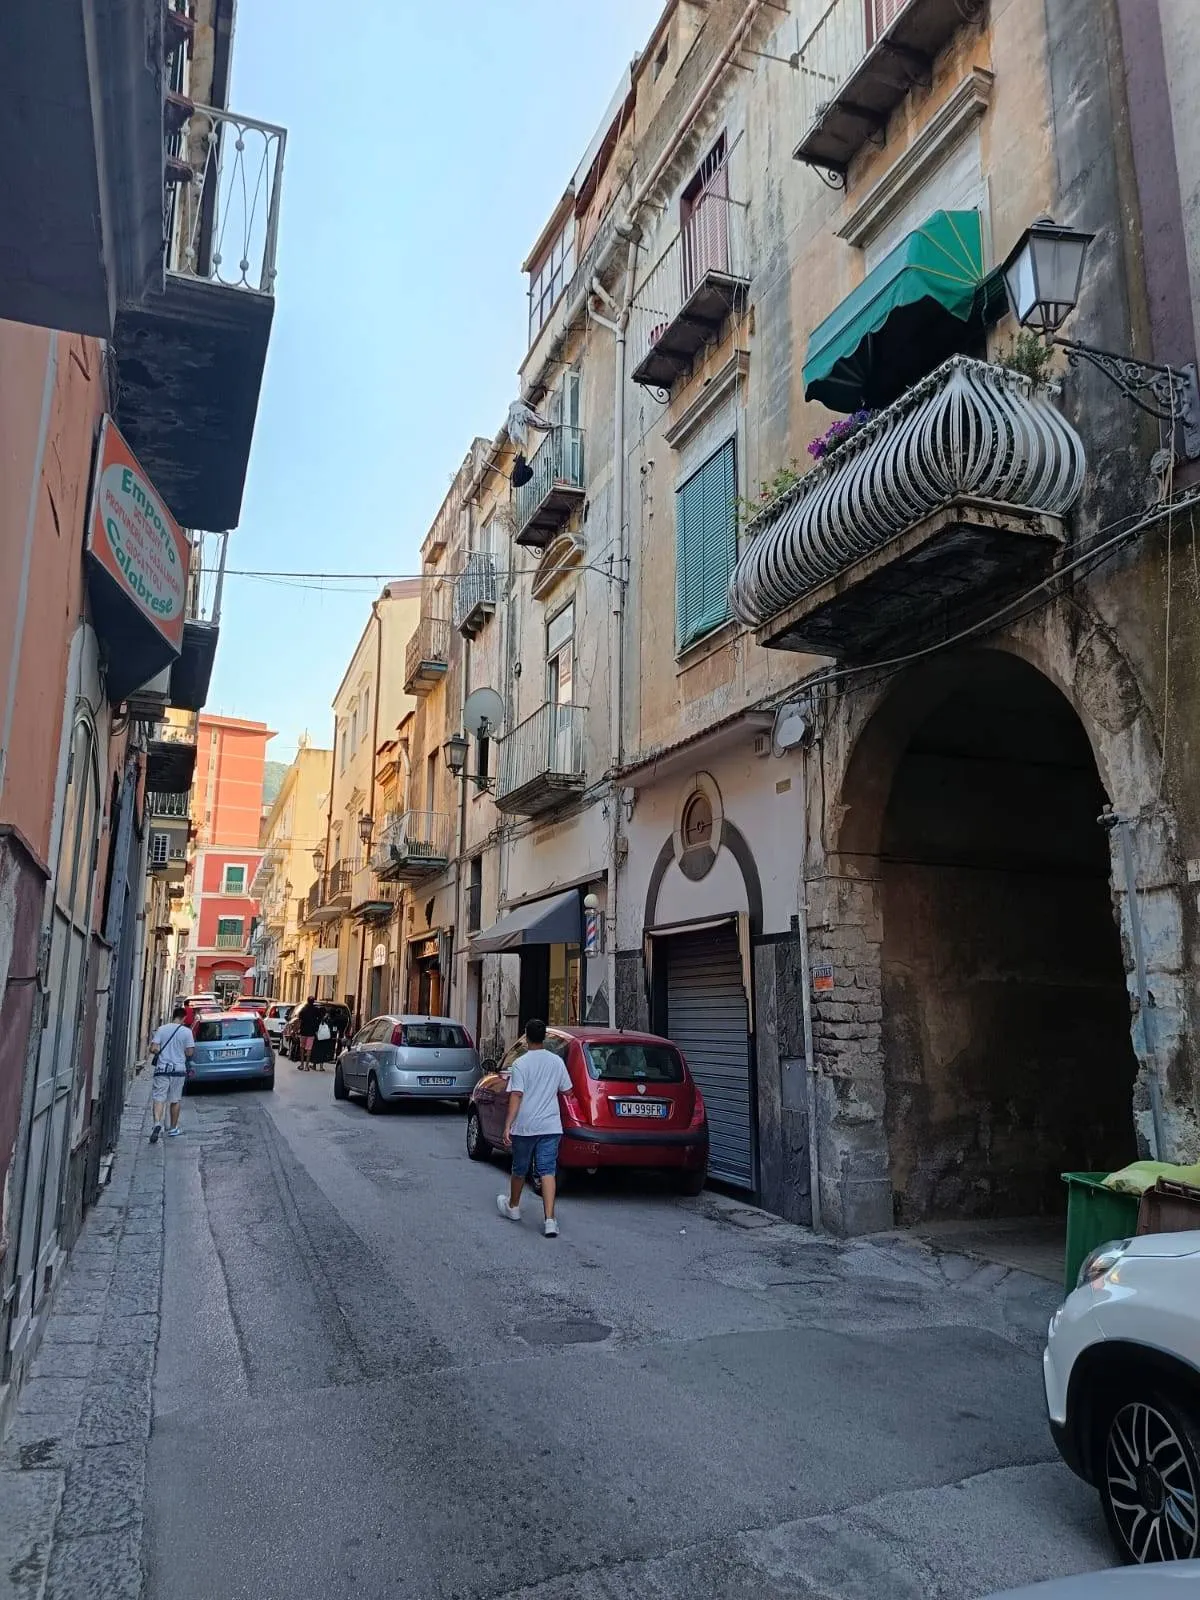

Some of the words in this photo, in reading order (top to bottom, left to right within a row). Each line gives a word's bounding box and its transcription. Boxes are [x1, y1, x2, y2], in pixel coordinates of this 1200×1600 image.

[121, 468, 176, 565] Emporio
[106, 517, 174, 614] Calabrese
[621, 1103, 632, 1114] CW
[634, 1104, 661, 1115] 999FR
